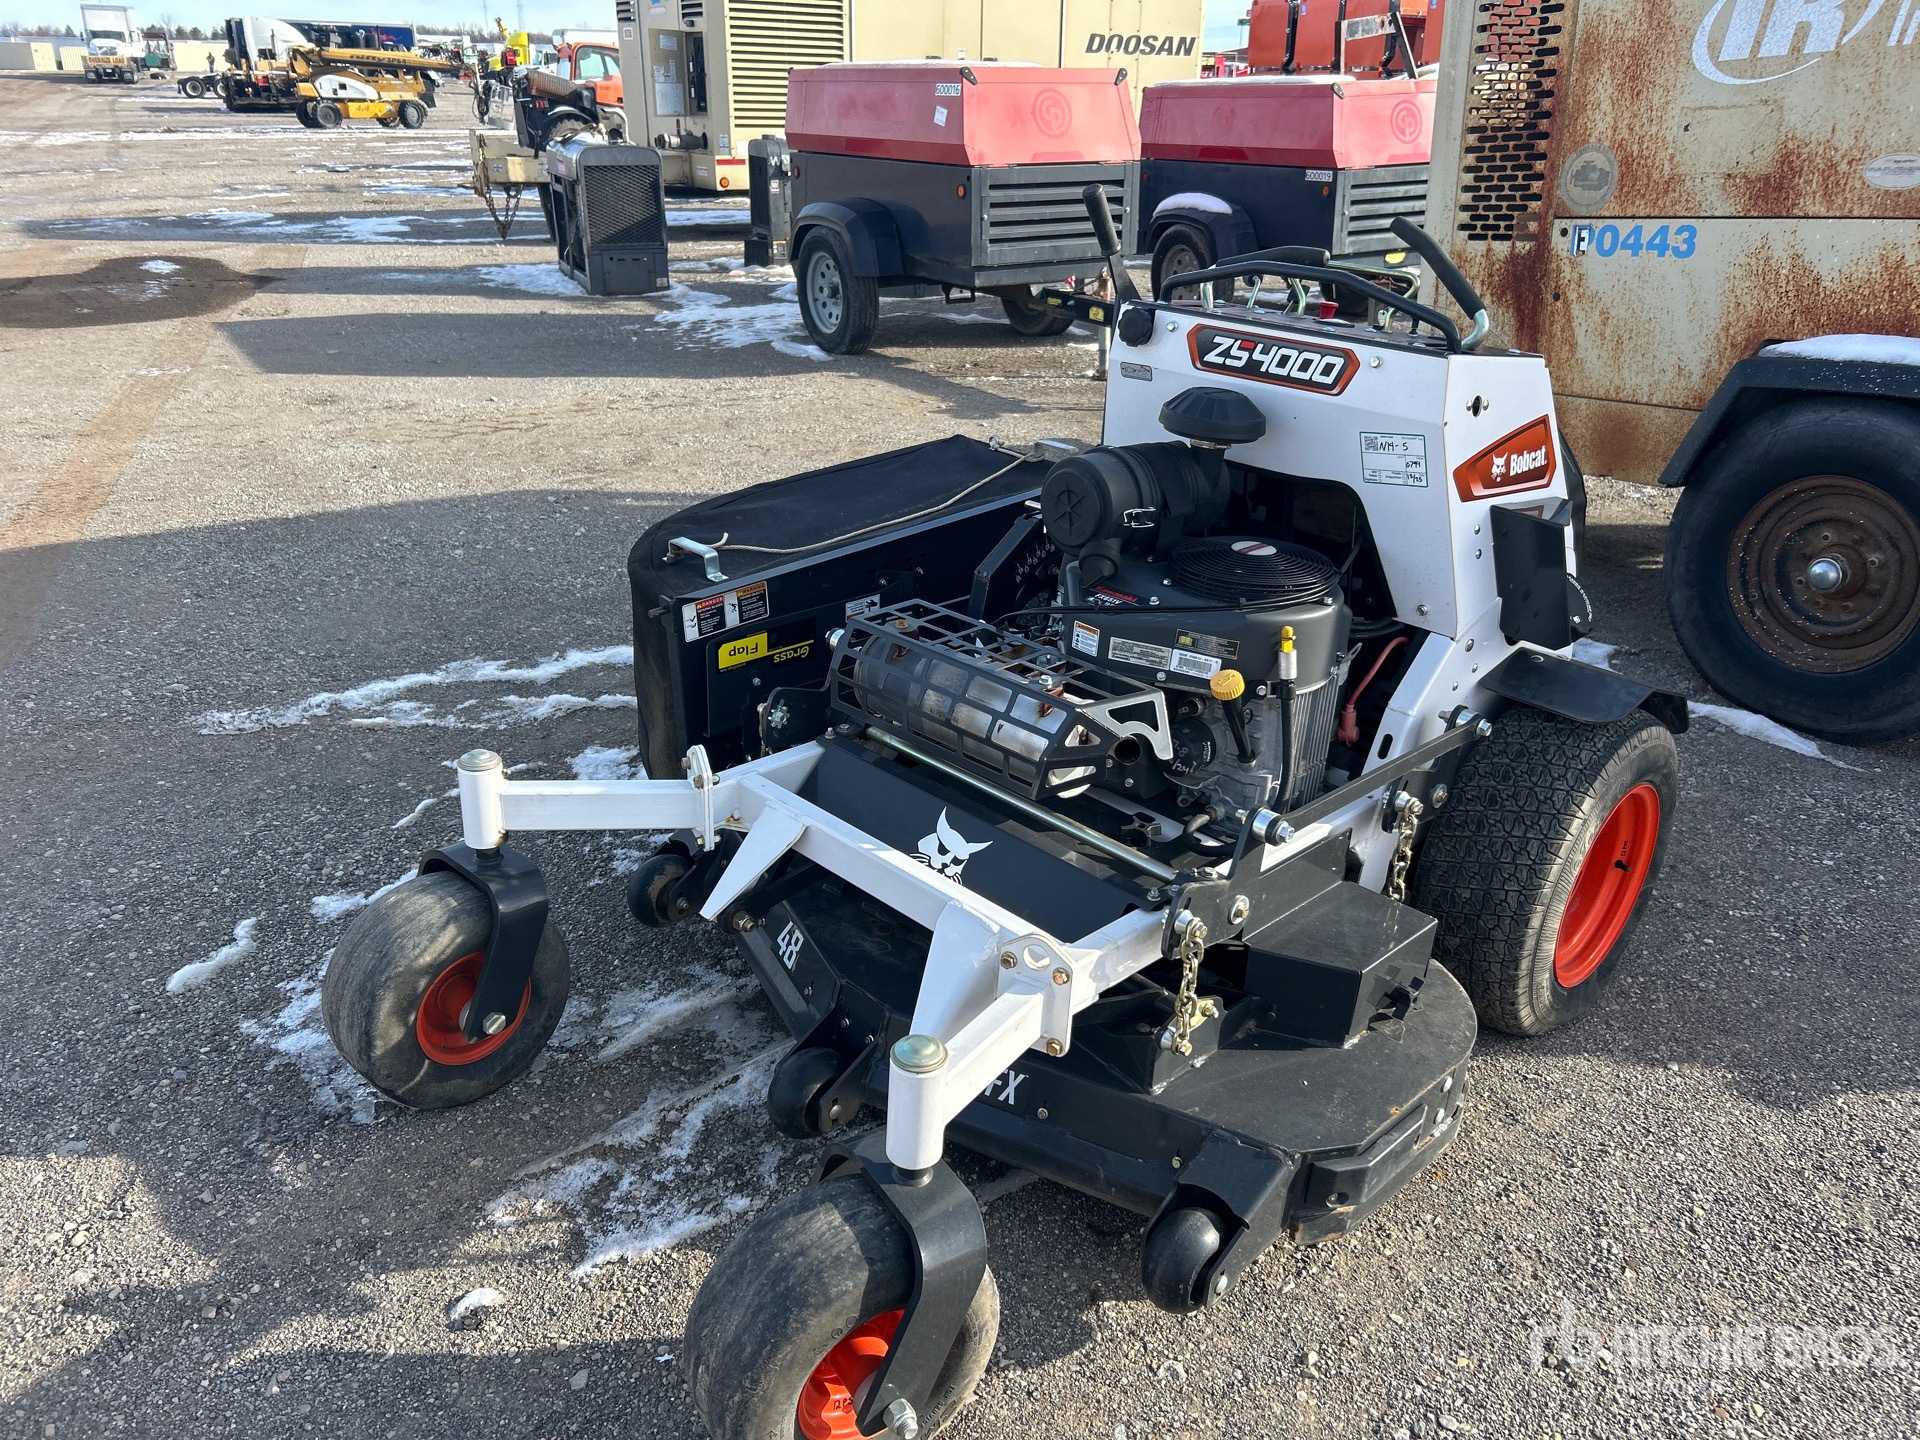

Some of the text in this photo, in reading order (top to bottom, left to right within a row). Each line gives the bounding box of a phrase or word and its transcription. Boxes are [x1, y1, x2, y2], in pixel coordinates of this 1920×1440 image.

[1085, 33, 1196, 57] DOOSAN
[88, 56, 125, 64] OVERSIZE LOAD
[935, 83, 961, 96] 600016
[1305, 170, 1332, 182] 600019
[1203, 334, 1346, 385] ZS4000
[1509, 445, 1547, 476] Bobcat
[701, 596, 724, 607] DANGER
[1094, 584, 1138, 603] Kawasaki
[728, 642, 759, 657] Flap
[773, 645, 810, 663] Grass
[776, 920, 804, 970] 48
